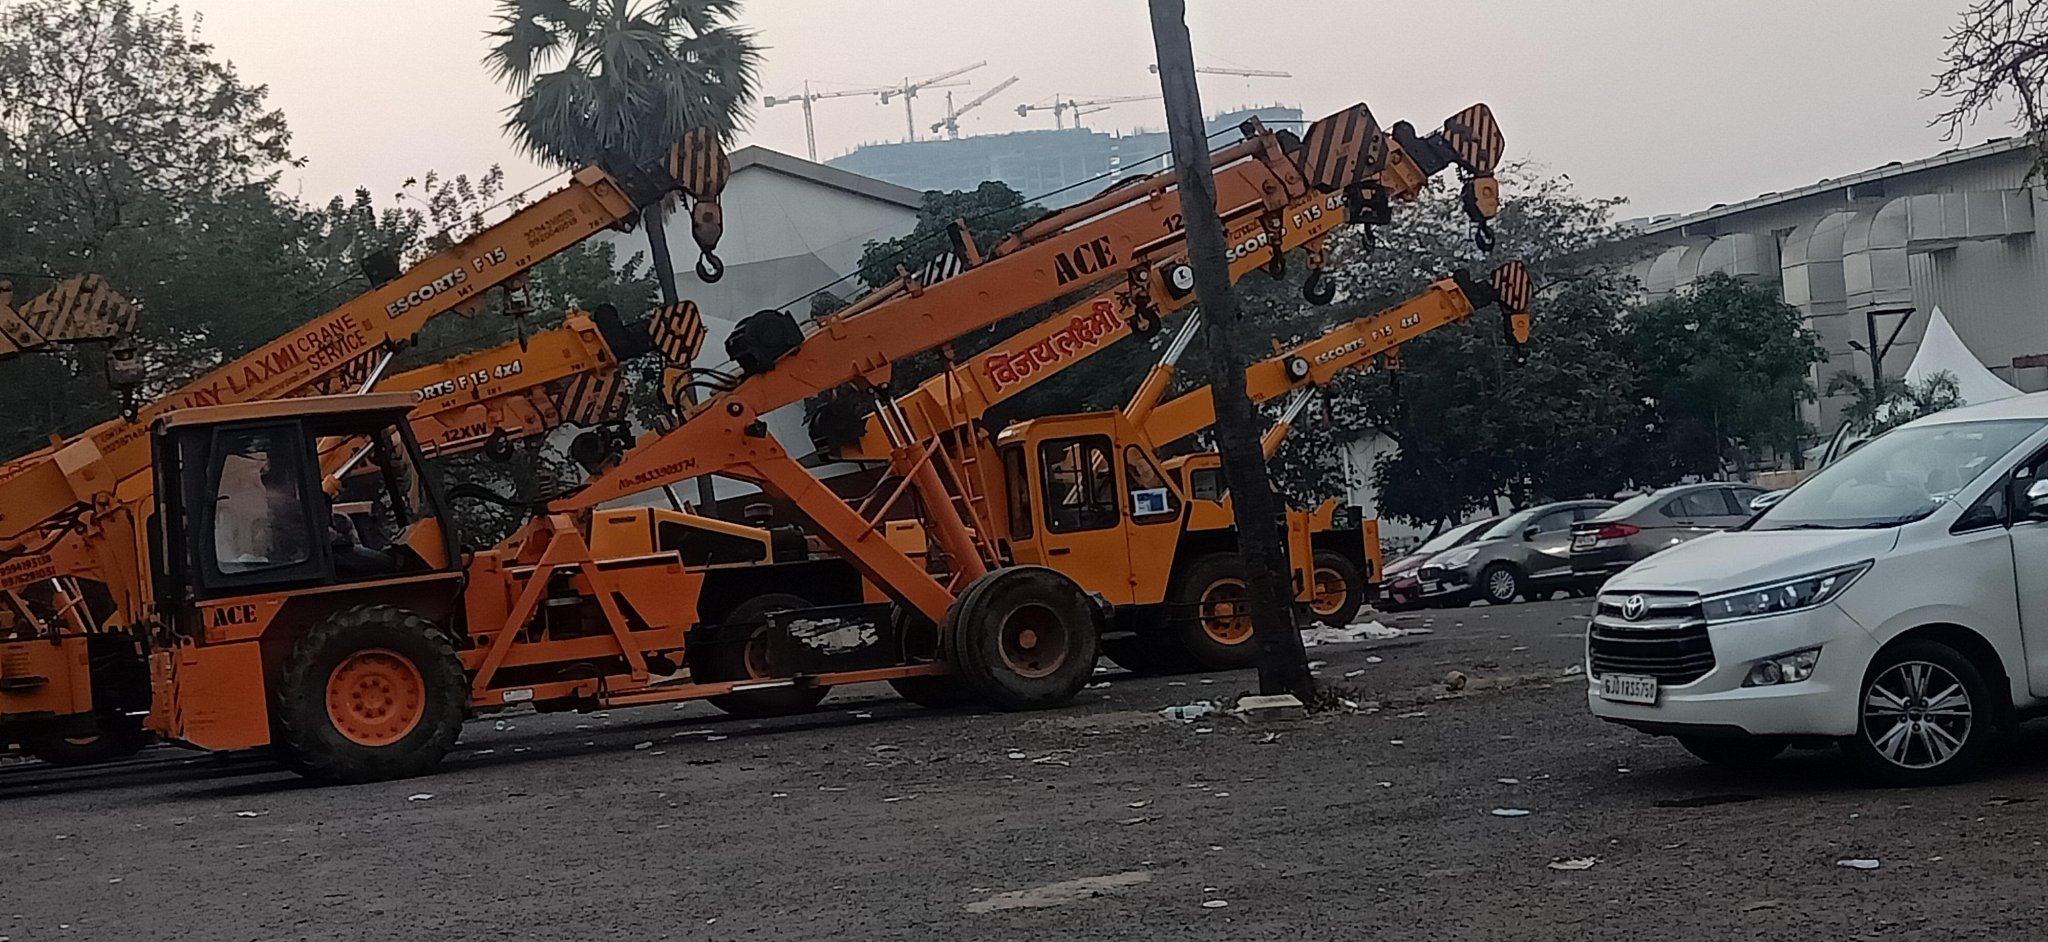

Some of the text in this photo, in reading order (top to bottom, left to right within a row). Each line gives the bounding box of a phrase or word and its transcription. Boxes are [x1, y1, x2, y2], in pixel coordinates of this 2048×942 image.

[1053, 235, 1119, 287] ACE
[386, 267, 468, 319] ESCORTS
[226, 343, 300, 394] LAXMI
[296, 313, 357, 352] CRANE
[307, 329, 367, 371] SERVICE
[984, 337, 1061, 393] विजय
[1051, 299, 1123, 357] लक्ष्मी
[1314, 337, 1367, 366] ESCORTS
[415, 379, 456, 402] ORTS
[441, 422, 488, 442] 12XW
[213, 604, 258, 627] ACE
